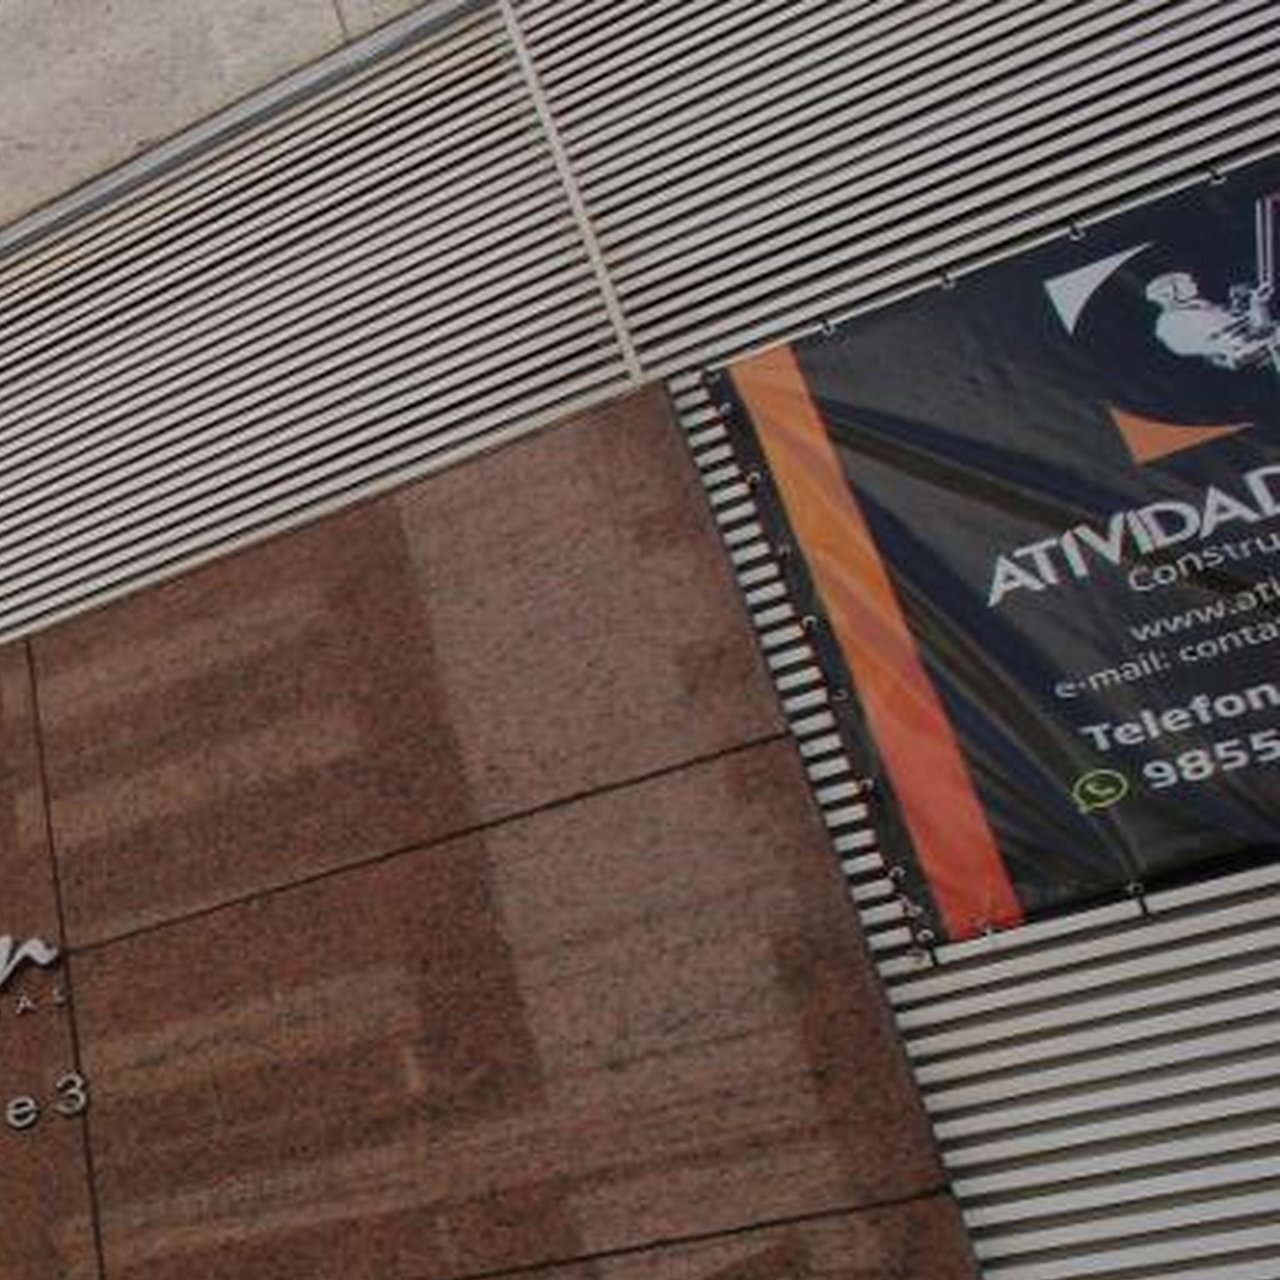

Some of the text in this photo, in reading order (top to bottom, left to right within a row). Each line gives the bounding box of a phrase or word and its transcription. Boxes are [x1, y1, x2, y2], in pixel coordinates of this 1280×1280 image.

[1055, 617, 1280, 698] e-mail: conta
[1079, 683, 1280, 751] Telefon
[1143, 729, 1280, 788] 9855
[6, 1096, 39, 1128] e
[54, 1073, 87, 1115] 3
